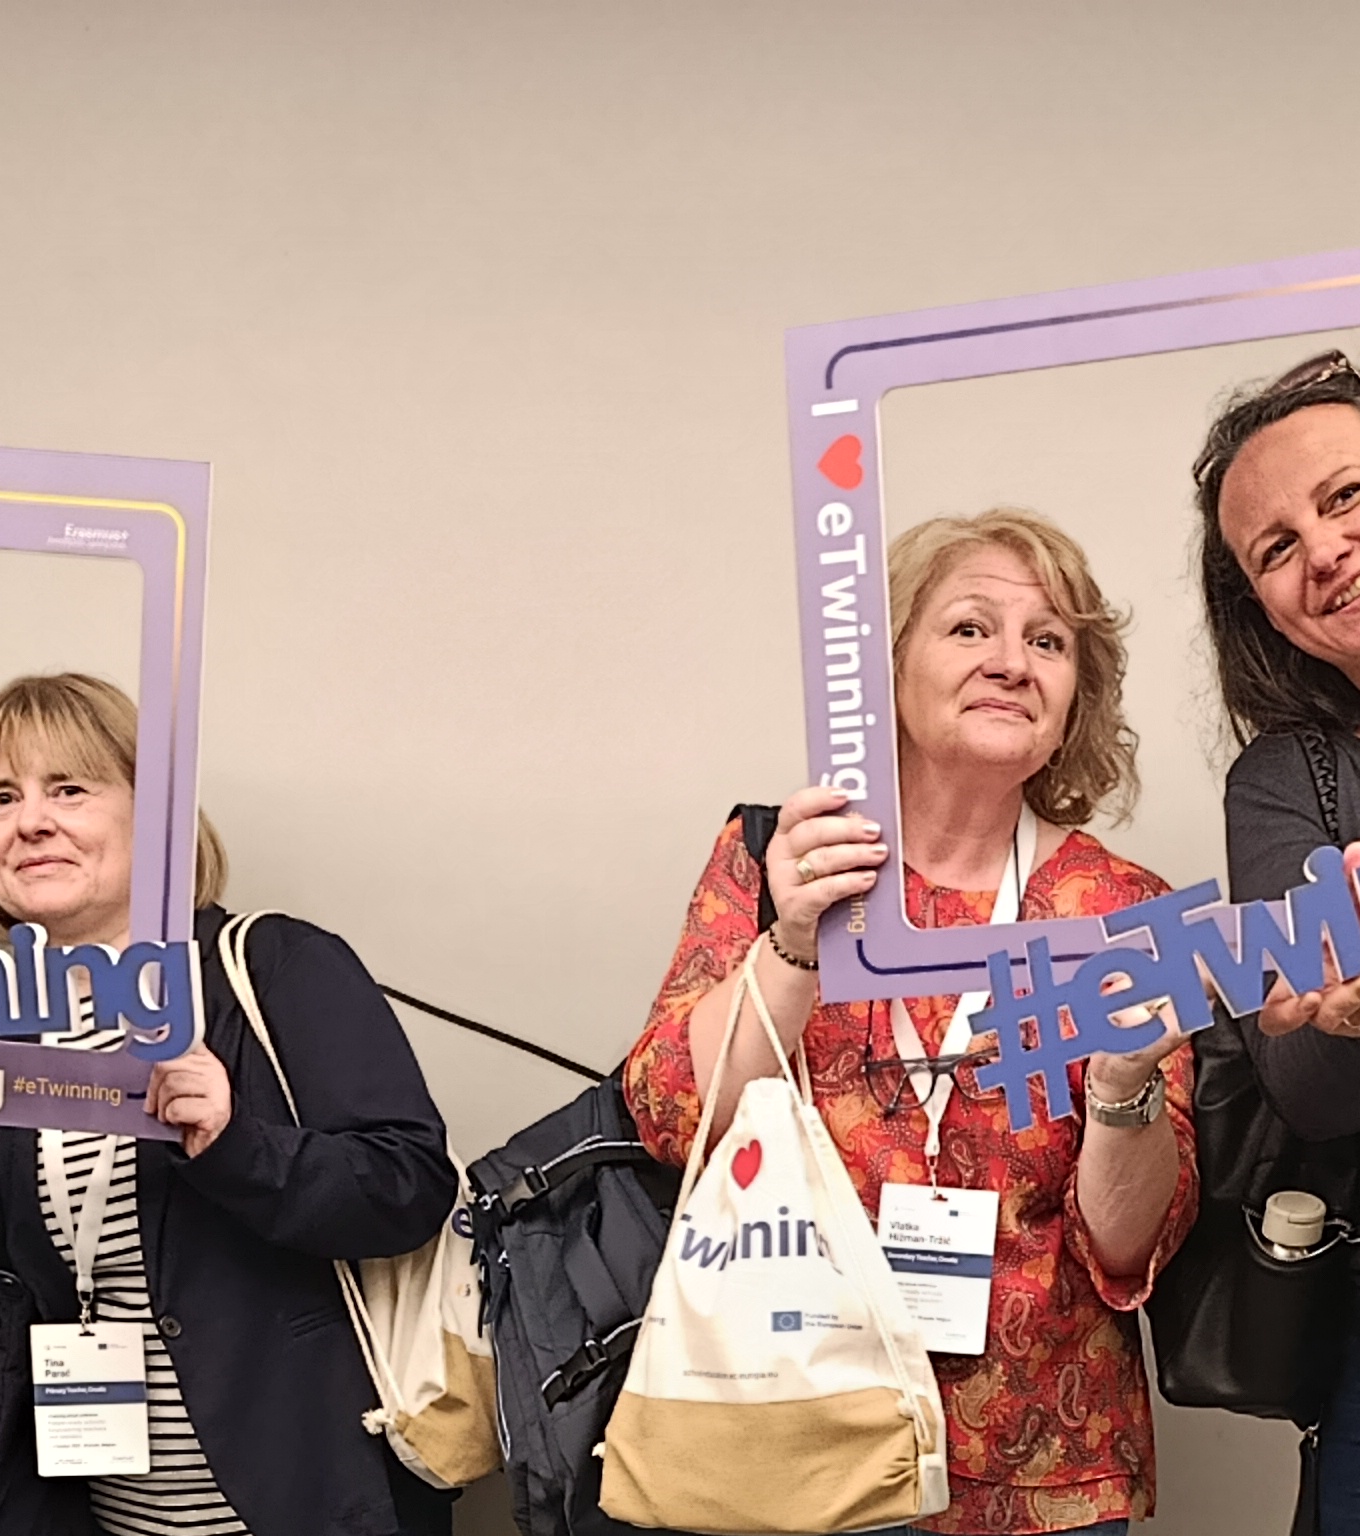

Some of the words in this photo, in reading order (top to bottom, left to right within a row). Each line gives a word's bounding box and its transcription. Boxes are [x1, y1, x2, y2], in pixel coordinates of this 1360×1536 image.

[811, 399, 859, 417] I
[816, 502, 876, 801] eTwinning
[13, 1076, 122, 1106] #eTwinning
[889, 1220, 920, 1231] Vlatka
[44, 1358, 65, 1367] Tina
